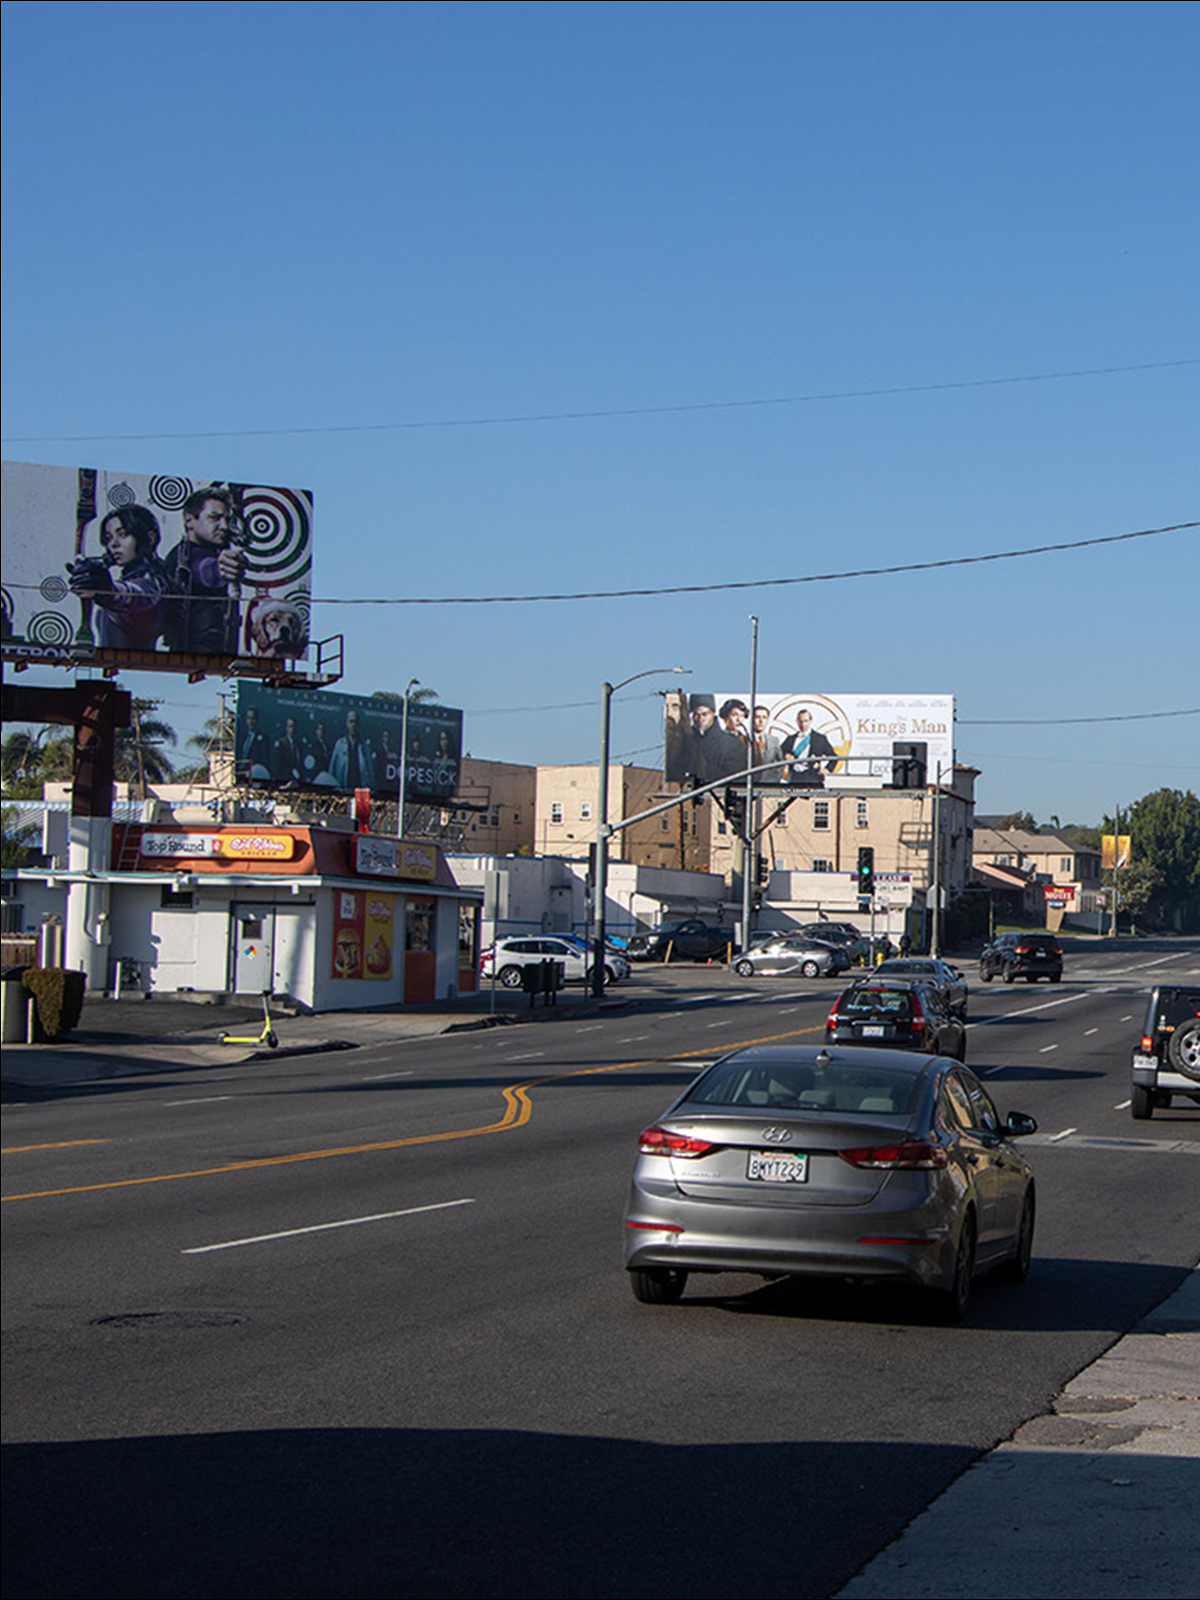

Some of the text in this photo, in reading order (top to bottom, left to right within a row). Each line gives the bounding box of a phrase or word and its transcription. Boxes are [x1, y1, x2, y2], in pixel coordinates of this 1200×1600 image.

[911, 718, 947, 734] Man
[146, 840, 166, 854] Top
[168, 839, 205, 852] Round
